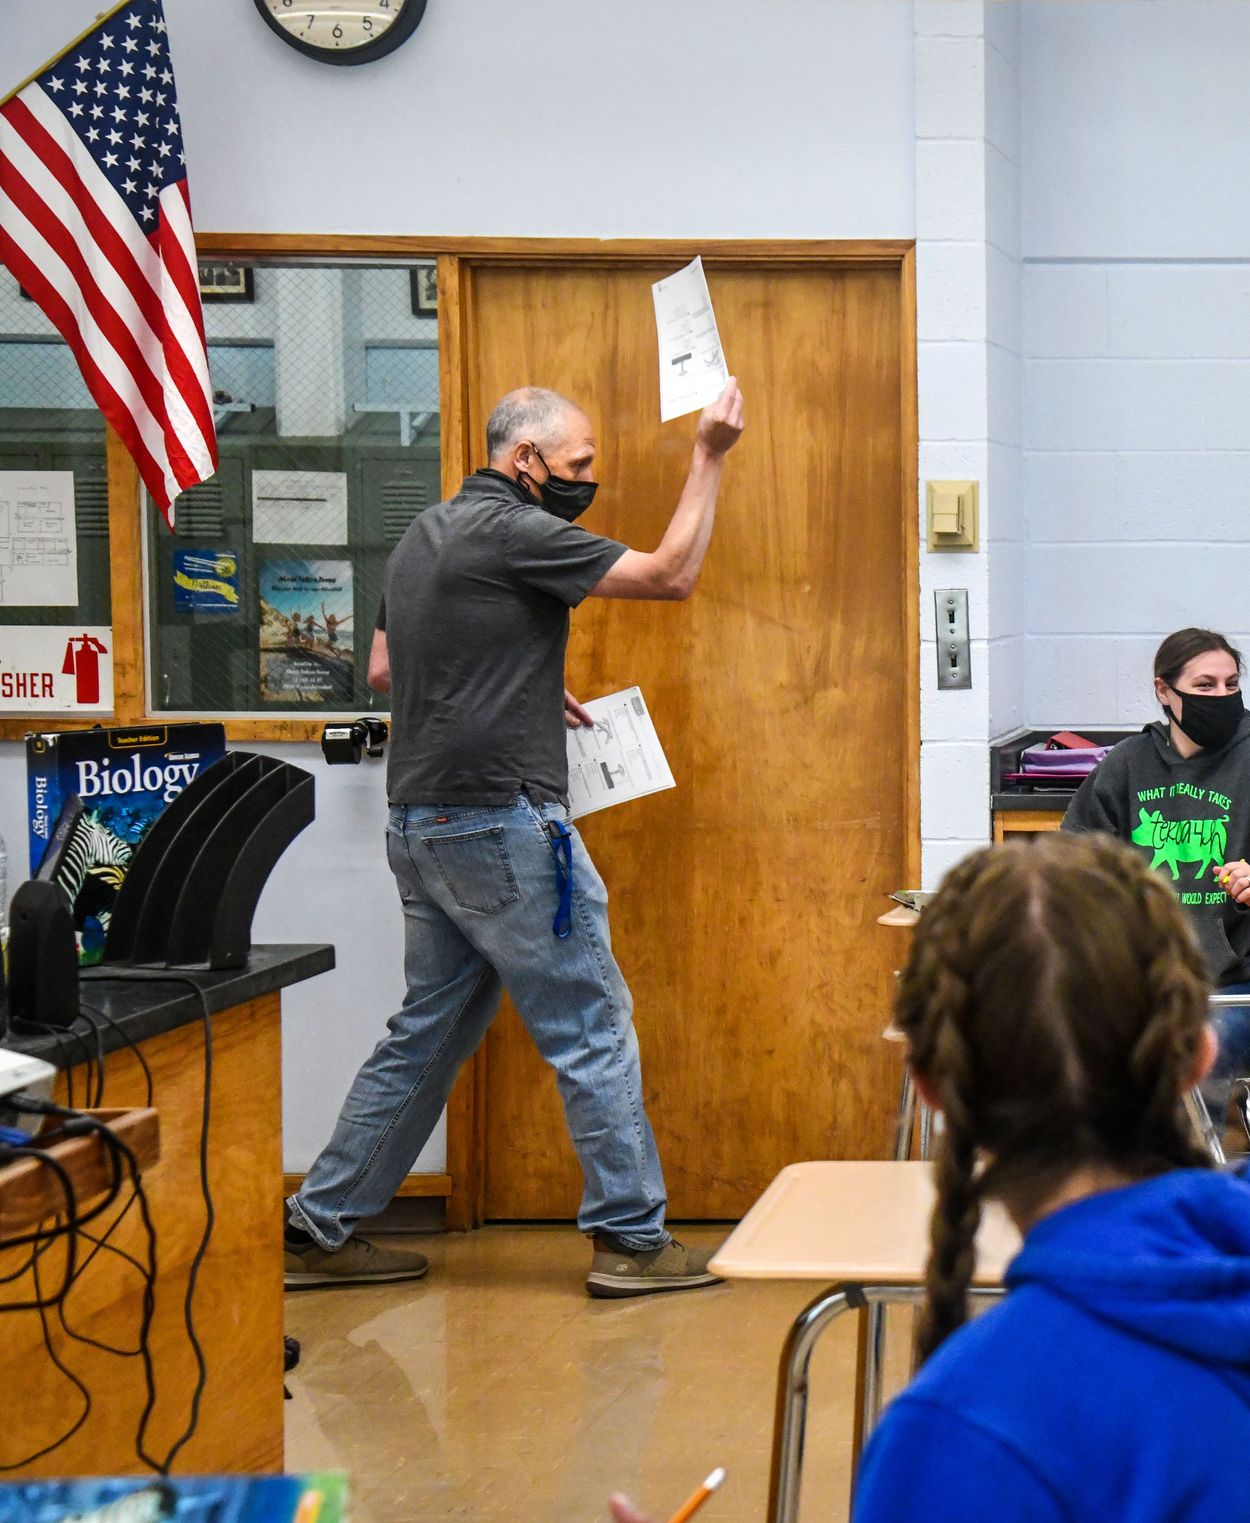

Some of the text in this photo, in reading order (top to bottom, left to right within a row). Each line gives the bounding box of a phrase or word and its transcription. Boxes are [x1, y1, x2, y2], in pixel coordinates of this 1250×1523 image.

[305, 14, 314, 29] 7
[332, 23, 343, 39] 6
[362, 15, 373, 31] 5
[1, 672, 54, 698] SHER
[139, 735, 160, 743] Edition
[75, 752, 200, 803] Biology
[32, 776, 48, 838] Biology
[1137, 787, 1166, 802] WHAT
[1208, 790, 1232, 811] TAKES
